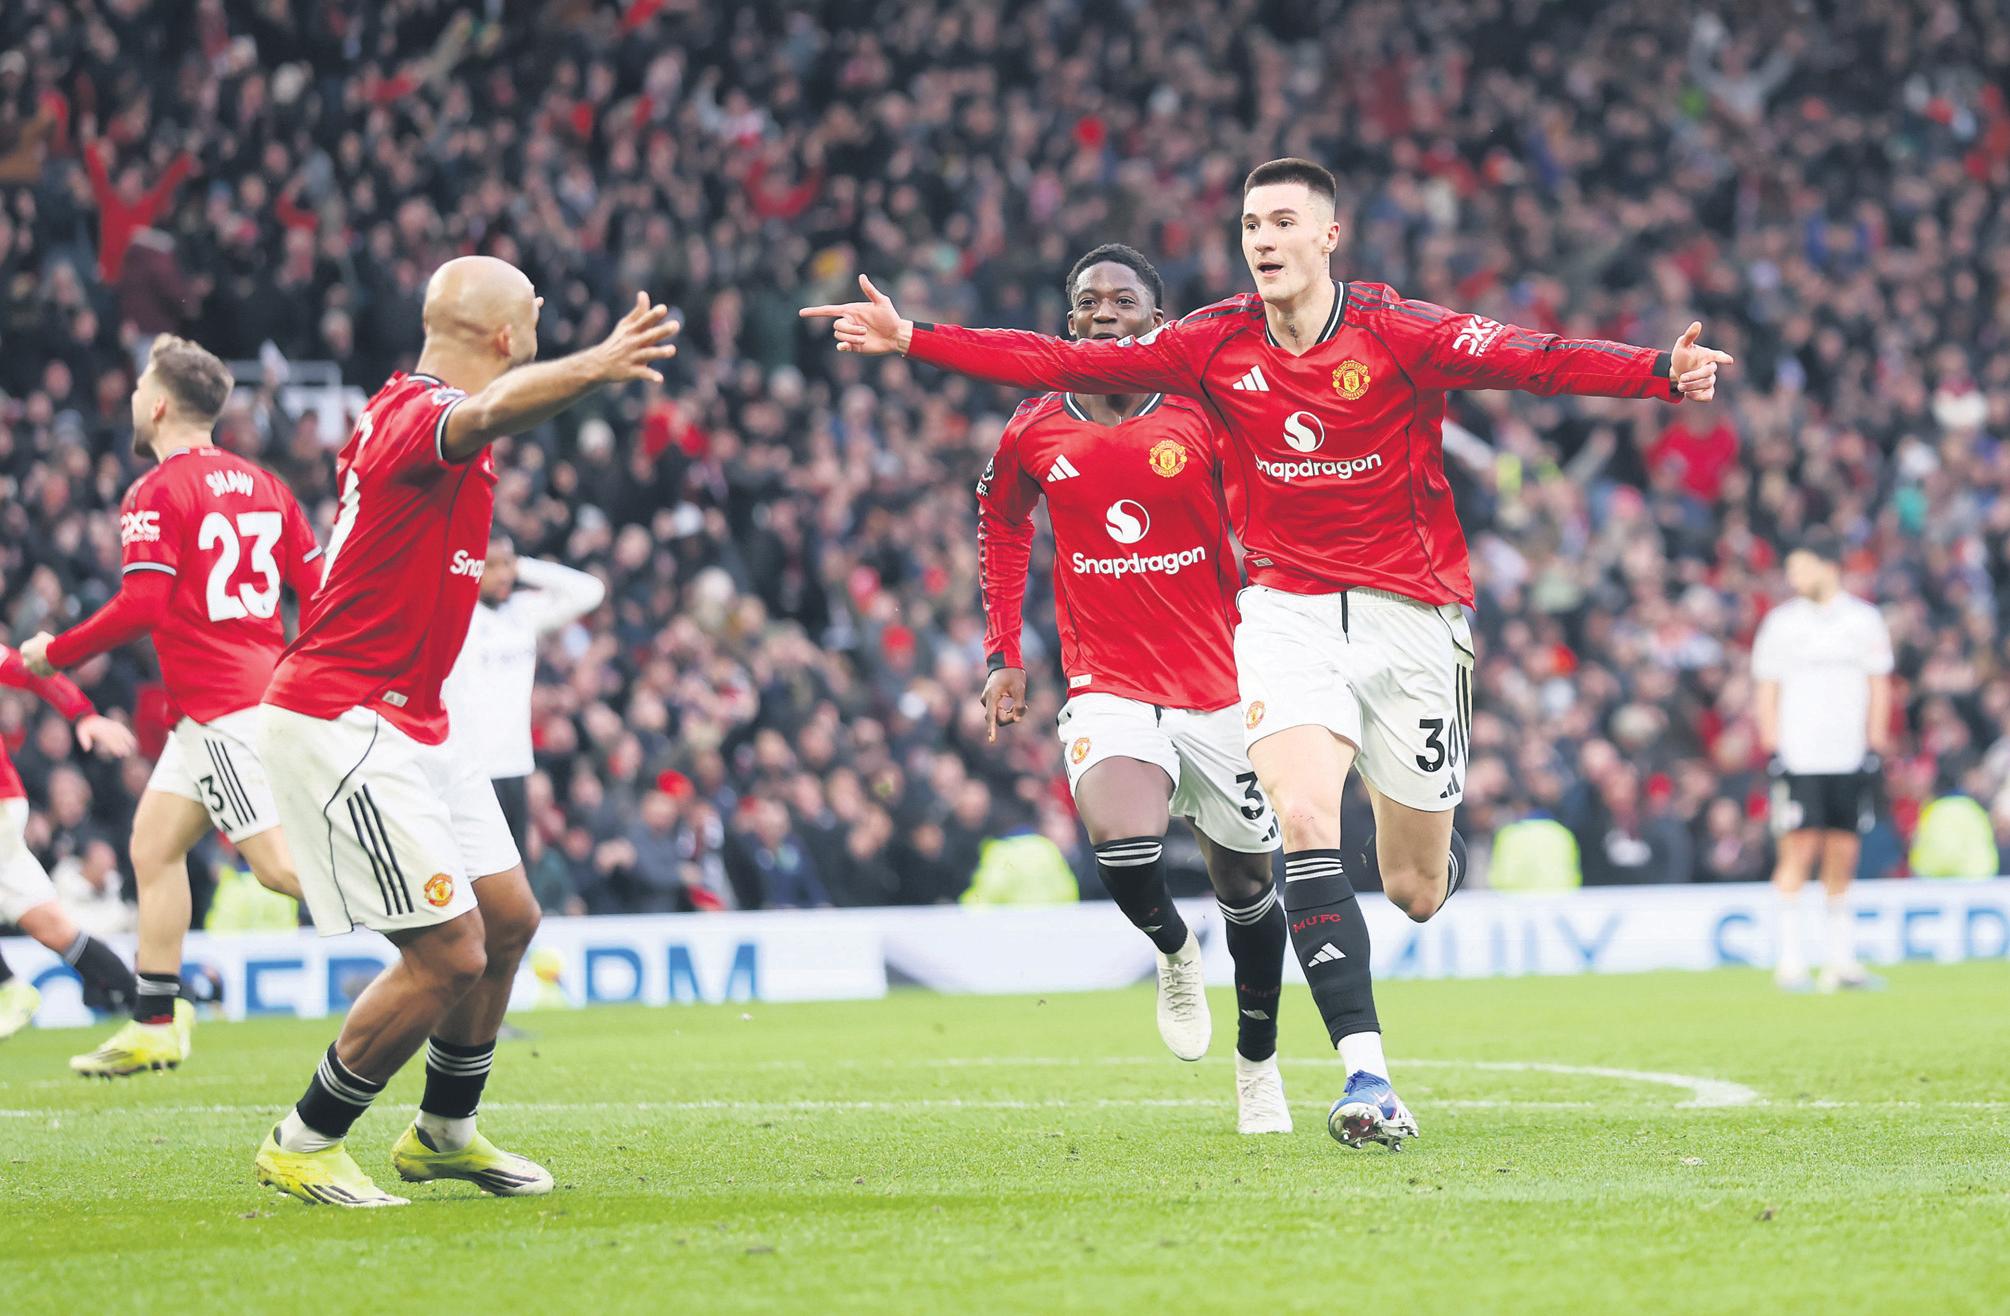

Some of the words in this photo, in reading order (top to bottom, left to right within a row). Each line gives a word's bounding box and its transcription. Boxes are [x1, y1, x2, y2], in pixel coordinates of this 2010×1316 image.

[205, 470, 254, 497] SHAW
[198, 511, 282, 622] 23
[1072, 546, 1206, 579] Snapdragon
[1415, 717, 1459, 773] 30
[199, 774, 224, 813] 3
[1235, 771, 1265, 820] 3
[1292, 913, 1343, 934] MUFC
